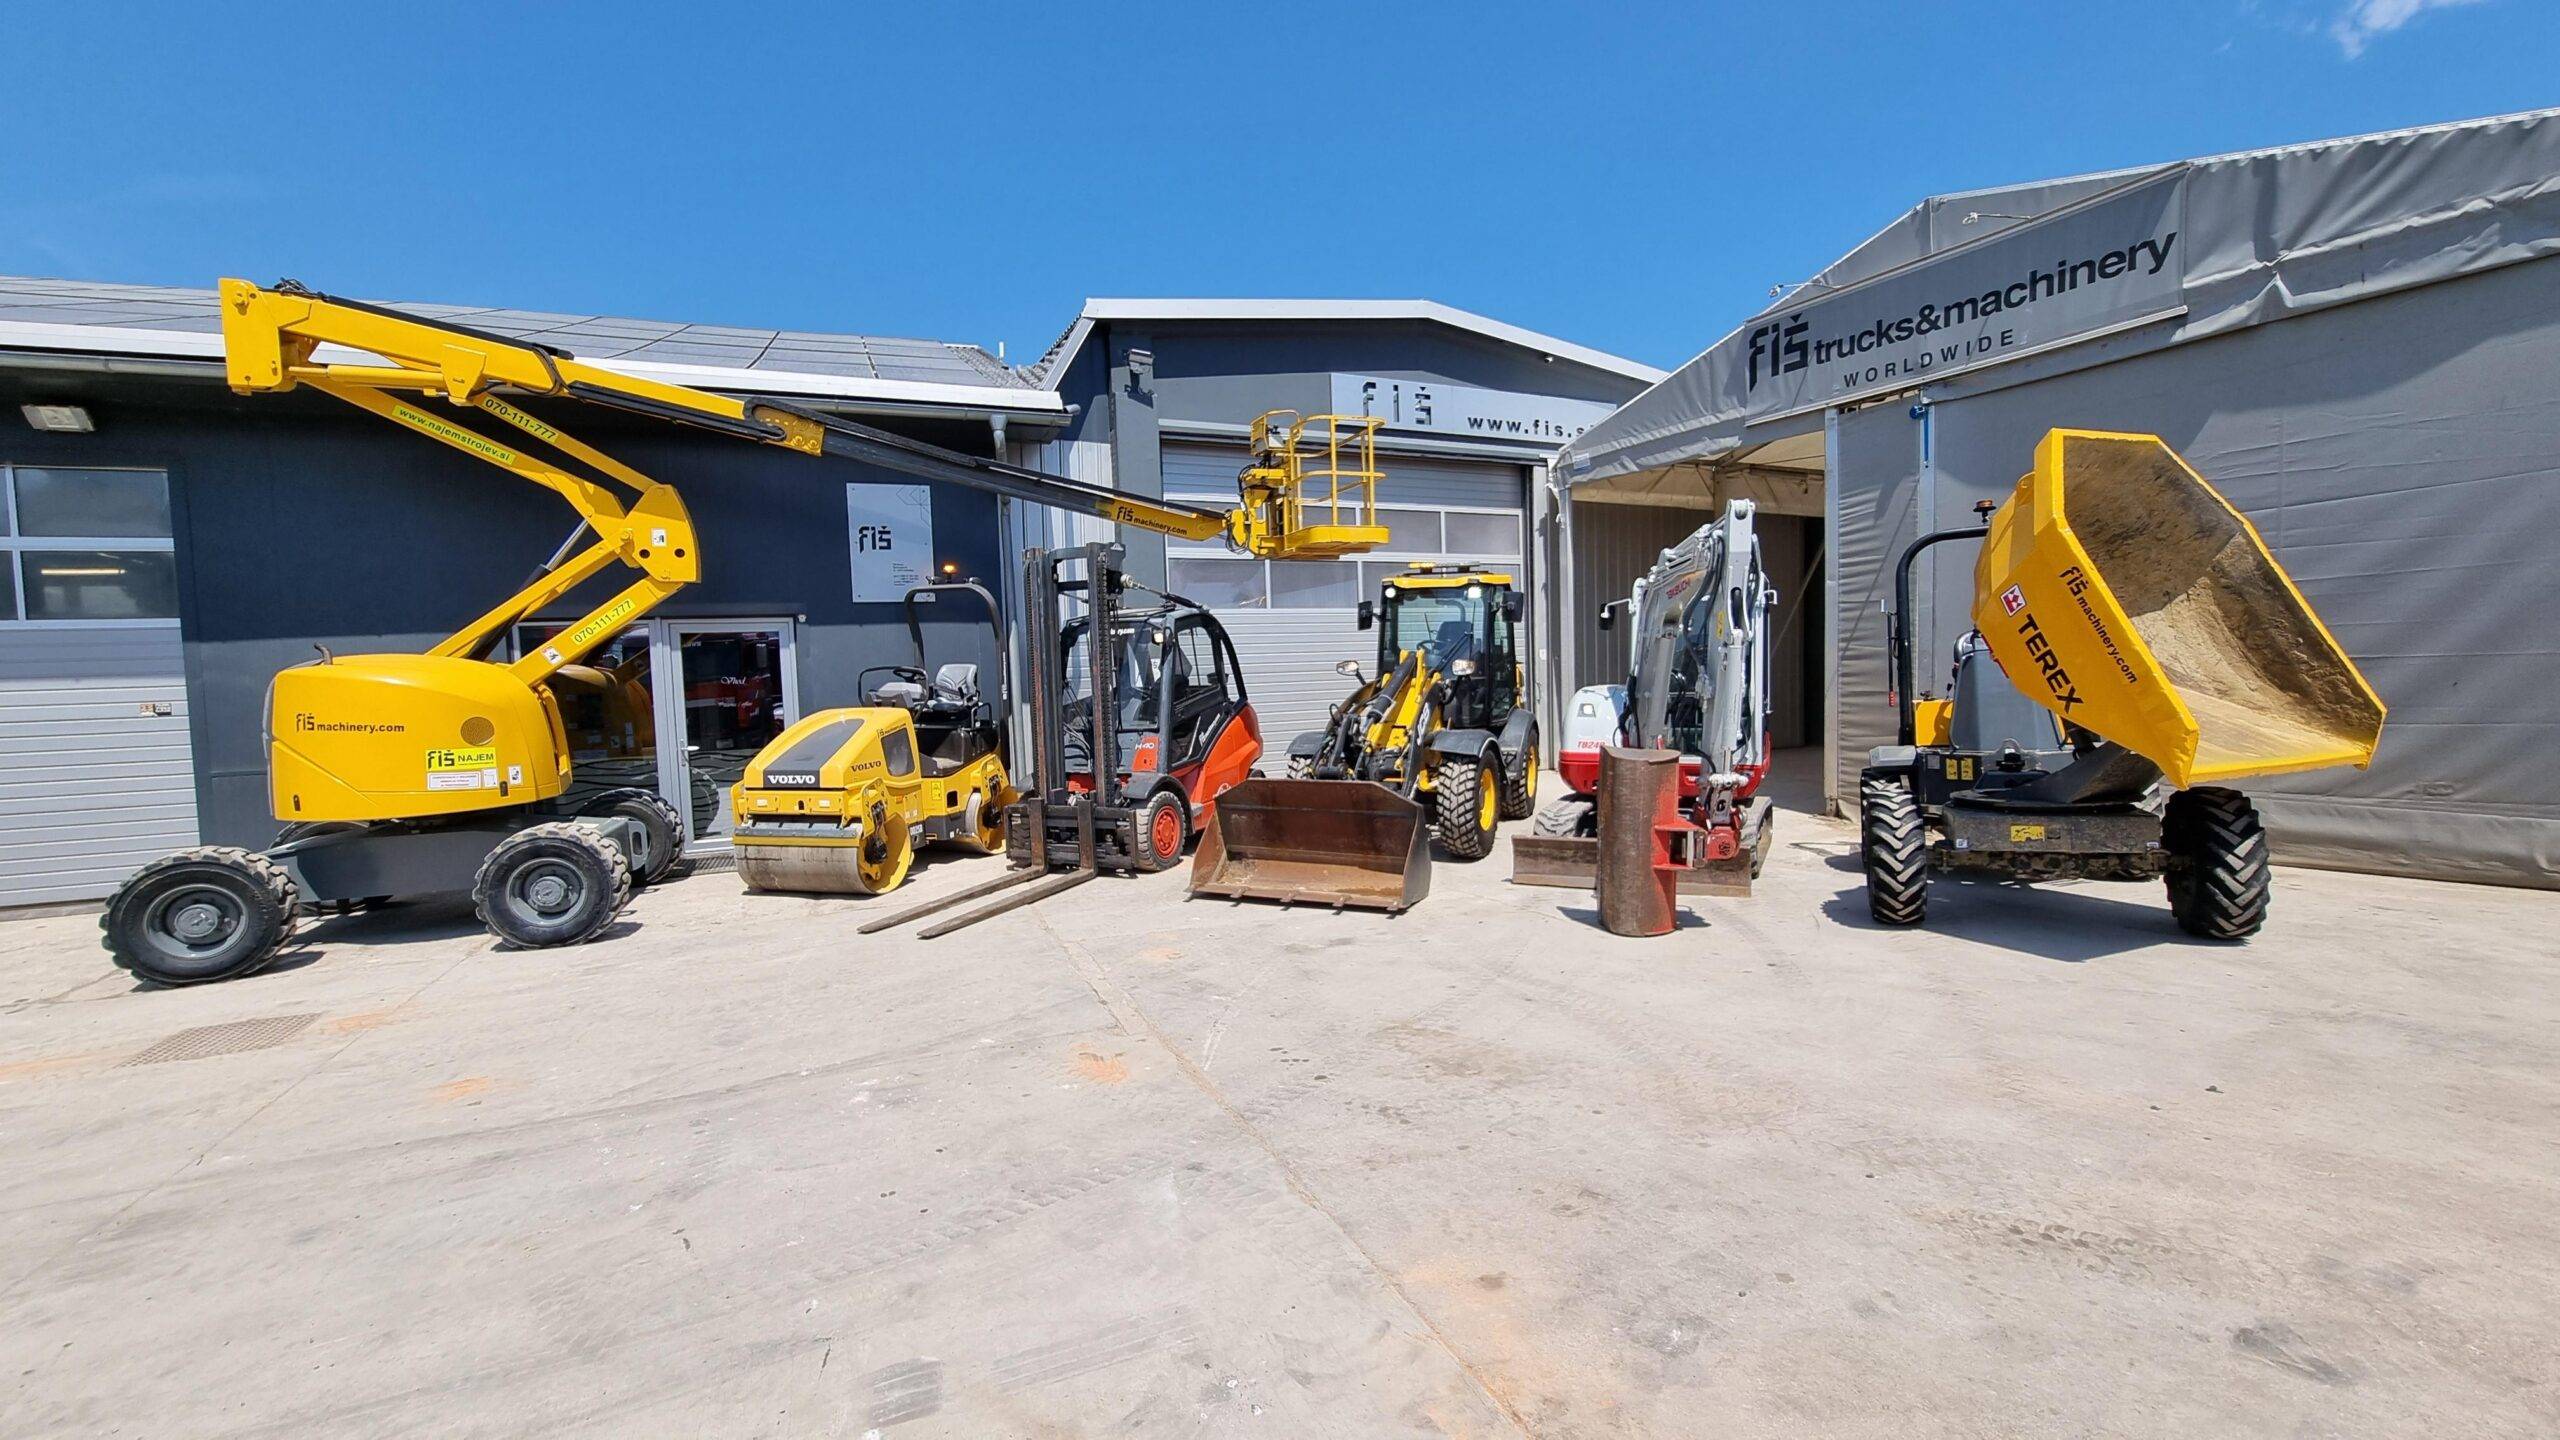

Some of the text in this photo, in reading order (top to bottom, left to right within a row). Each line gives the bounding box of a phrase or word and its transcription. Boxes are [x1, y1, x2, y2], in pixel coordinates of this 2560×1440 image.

[1814, 231, 2178, 366] trucks&machinery
[1844, 329, 2015, 389] WORLDWIDE
[399, 408, 511, 461] www.najemstrojev.si
[485, 398, 557, 440] 070-111-777
[1467, 416, 1595, 438] www.fis.s
[1133, 517, 1188, 536] machinery.com
[574, 600, 632, 643] 070-111-777
[2076, 596, 2138, 684] machinery.com
[2018, 613, 2084, 715] TEREX
[317, 722, 405, 734] machinery.com
[457, 753, 494, 763] NAJEM
[851, 760, 882, 772] VOLVO
[767, 774, 816, 785] VOLVO
